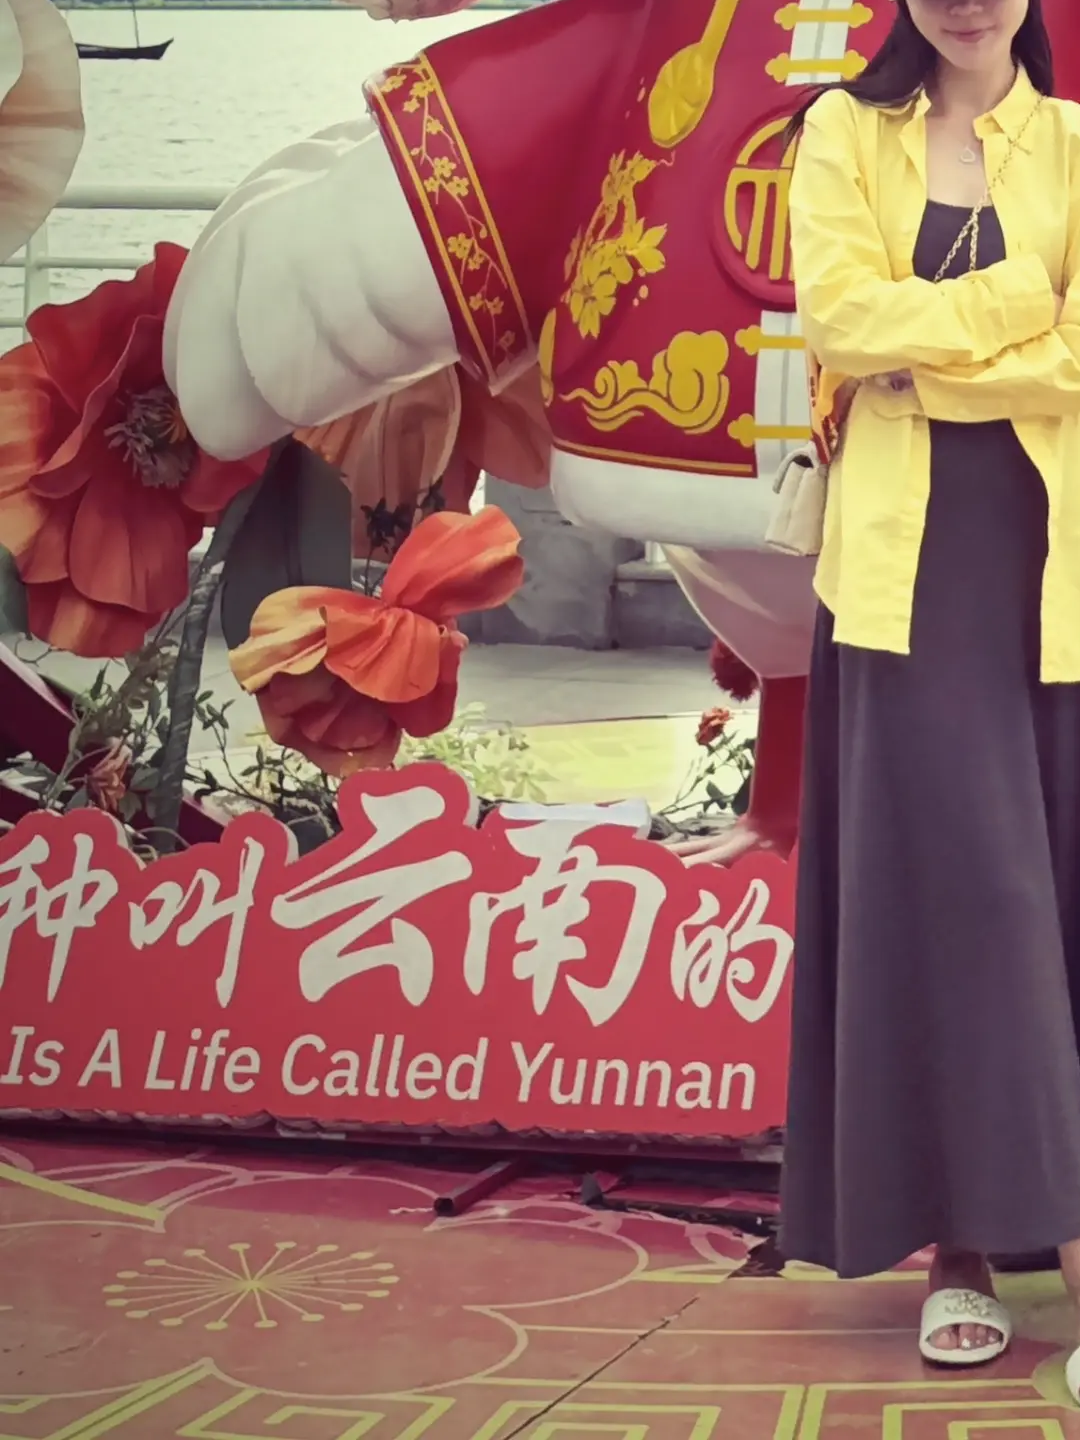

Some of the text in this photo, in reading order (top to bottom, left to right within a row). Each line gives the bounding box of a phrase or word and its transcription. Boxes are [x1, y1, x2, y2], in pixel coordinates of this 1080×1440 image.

[0, 785, 795, 1026] 种叫云南的
[0, 1025, 756, 1111] Is A Life Called Yunnan
